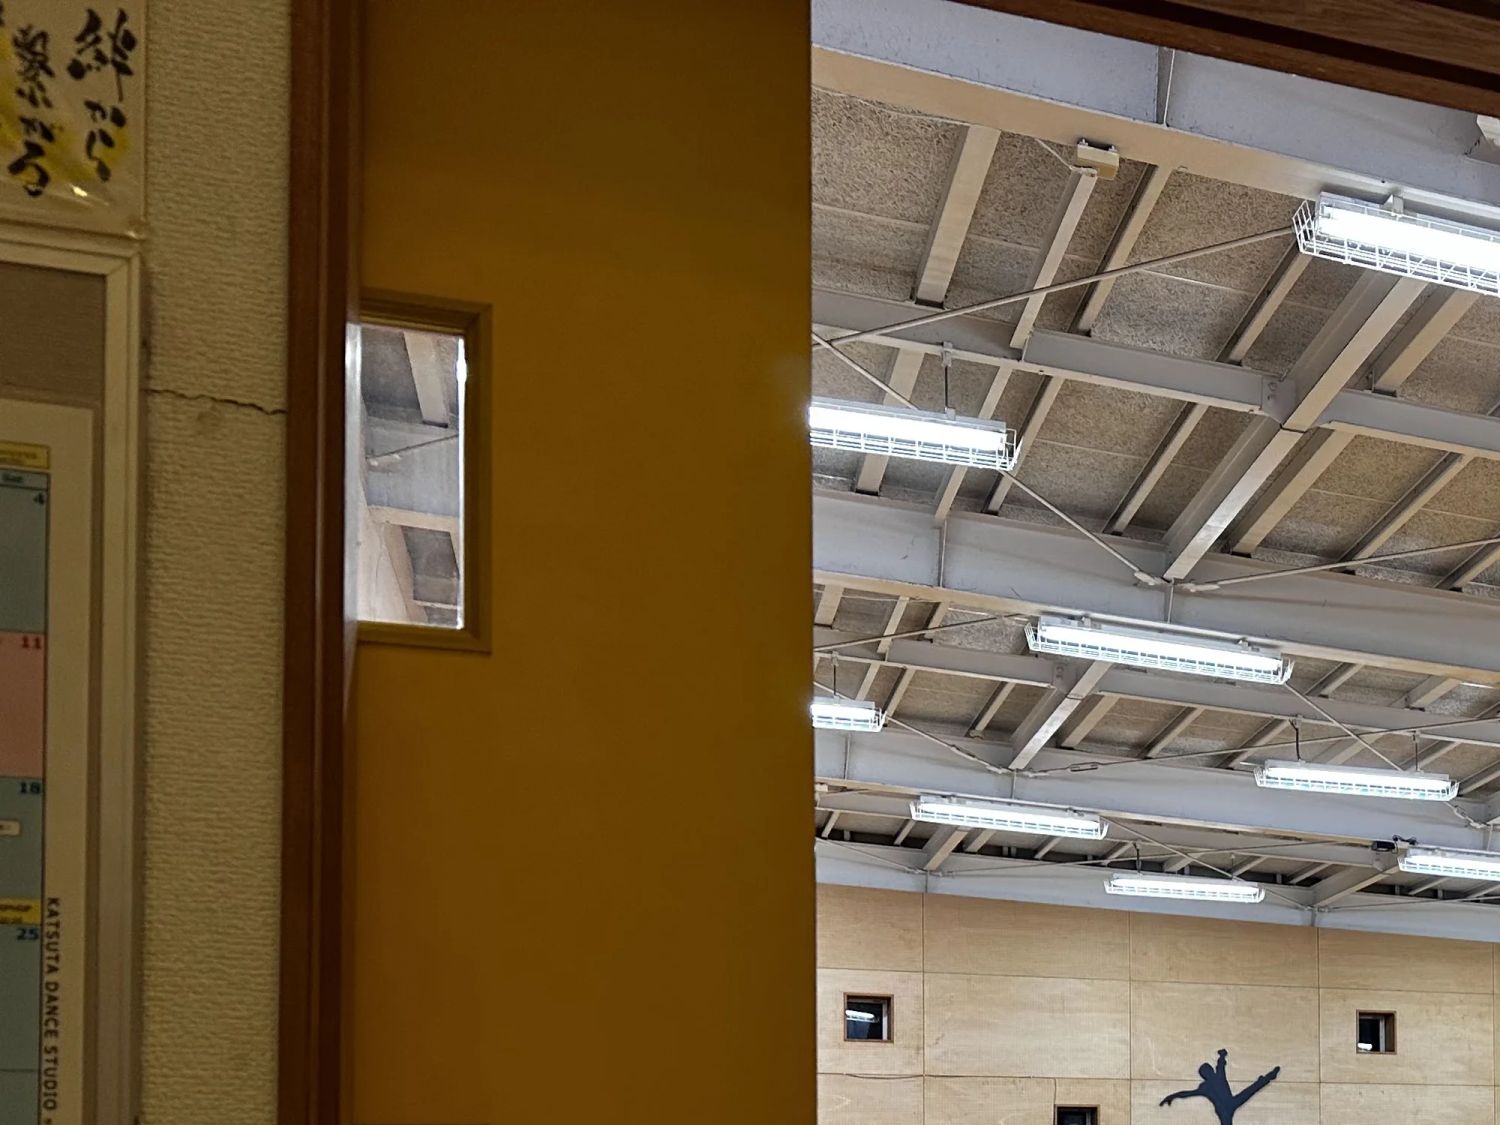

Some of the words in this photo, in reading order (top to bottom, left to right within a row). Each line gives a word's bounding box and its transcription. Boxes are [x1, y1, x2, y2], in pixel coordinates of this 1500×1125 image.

[33, 492, 45, 505] 4
[21, 635, 42, 650] 11
[19, 782, 41, 795] 18
[17, 927, 39, 941] 25
[44, 897, 60, 974] KATSUTA
[44, 981, 59, 1039] DANCE
[43, 1045, 58, 1110] STUDIO
